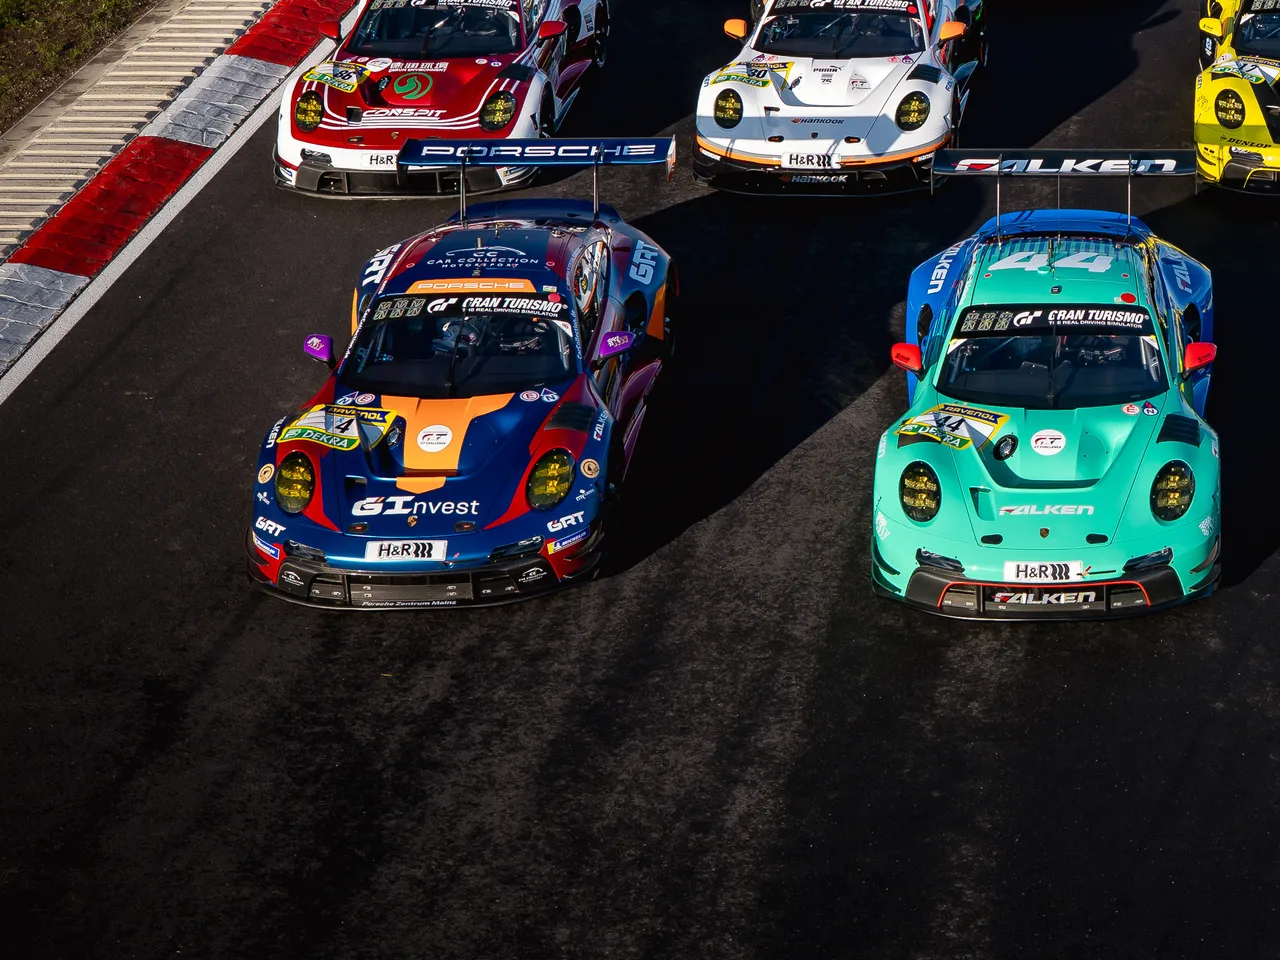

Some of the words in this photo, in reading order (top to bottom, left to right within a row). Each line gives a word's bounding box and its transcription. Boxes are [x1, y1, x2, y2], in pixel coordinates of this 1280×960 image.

[362, 107, 448, 119] CONSPIT
[421, 144, 657, 158] PORSCHE
[1226, 137, 1273, 150] DUNLOP
[369, 154, 394, 166] H&R
[952, 158, 1177, 174] FALKEN
[427, 258, 450, 266] CAR
[452, 256, 539, 265] COLLECTION
[629, 240, 660, 285] GRT
[987, 251, 1115, 273] 44
[417, 282, 526, 291] PORSCHE
[462, 296, 502, 309] GRAN
[503, 297, 562, 314] TURISMO
[521, 309, 559, 318] SIMULATOR
[1048, 309, 1086, 322] GRAN
[1088, 310, 1145, 324] TURISMO
[945, 405, 996, 421] RAVENOL
[335, 417, 353, 435] 4
[593, 407, 610, 442] FALKEN
[303, 429, 349, 449] DEKRA
[998, 504, 1095, 516] FALKEN
[255, 515, 287, 537] GRT
[546, 510, 586, 533] GRT
[362, 600, 394, 609] Porsche
[430, 599, 458, 607] Mainz
[993, 591, 1096, 605] FALKEN
